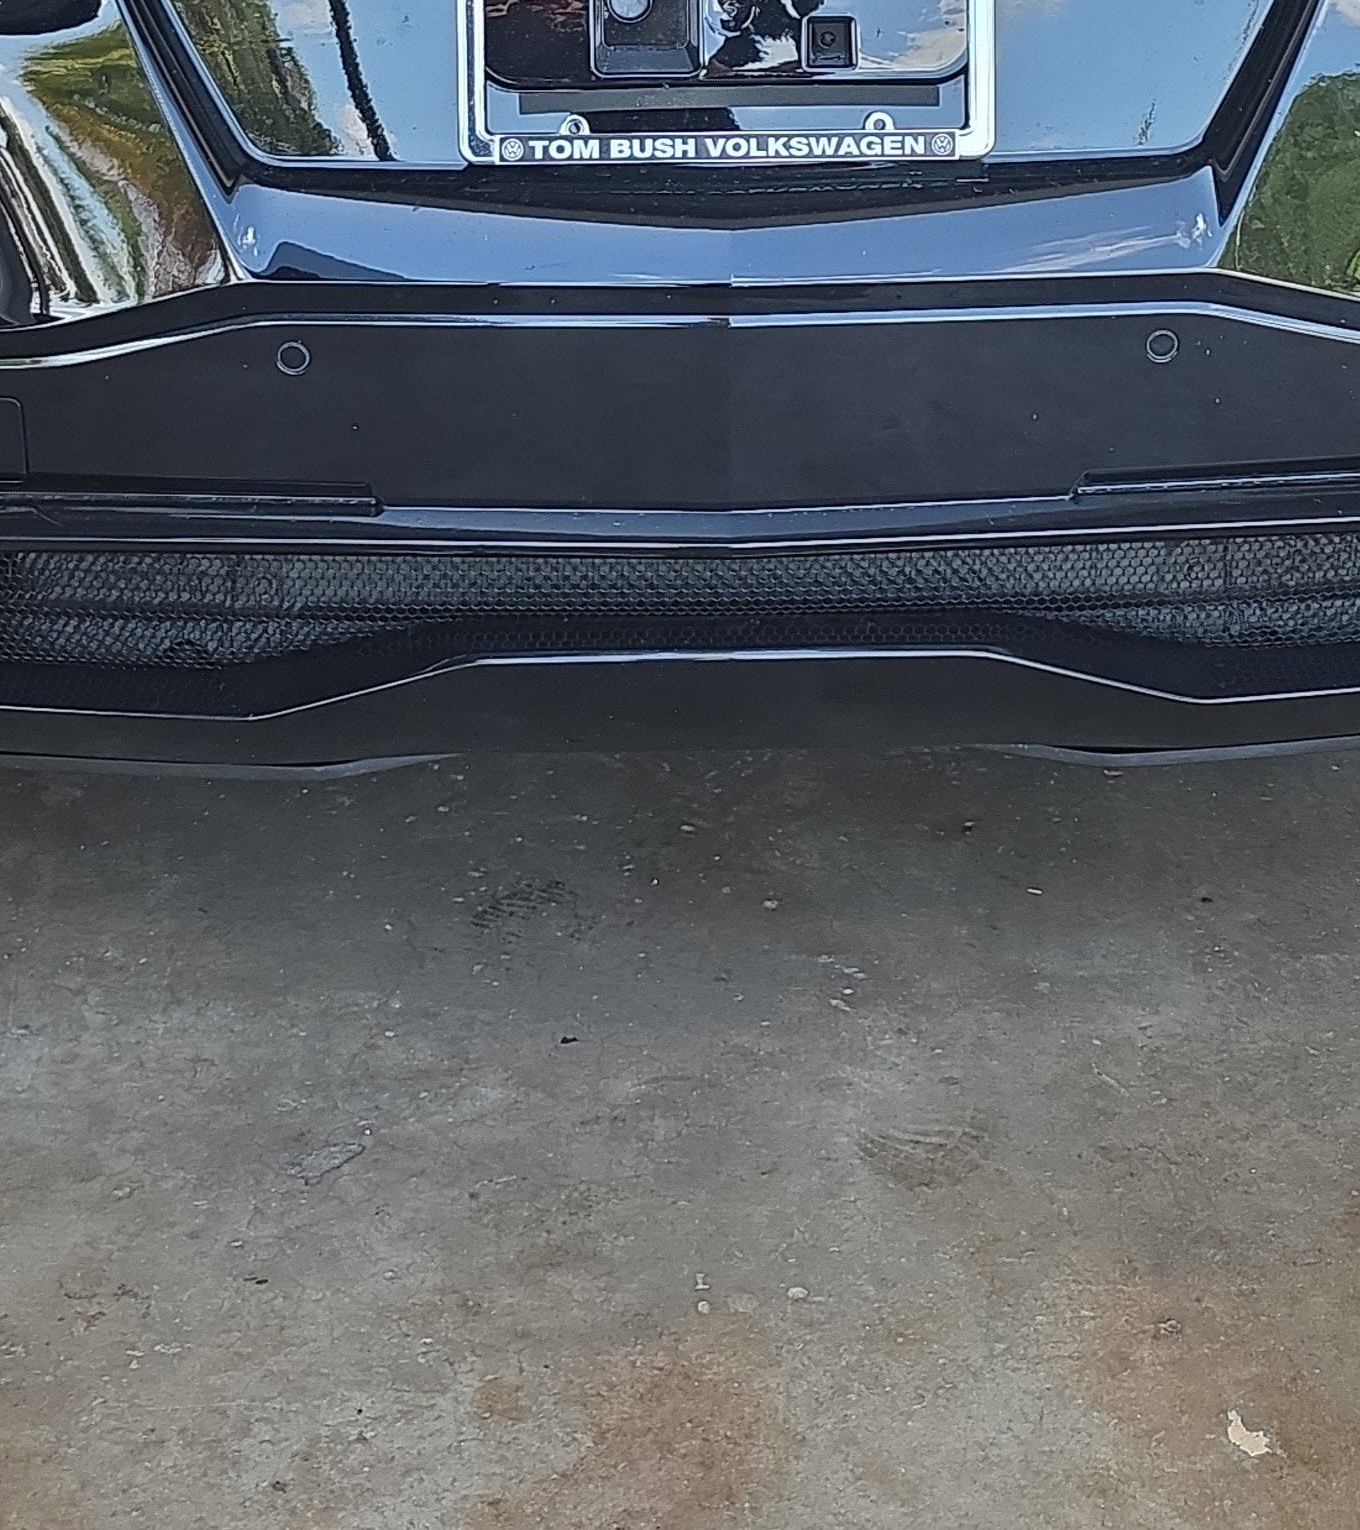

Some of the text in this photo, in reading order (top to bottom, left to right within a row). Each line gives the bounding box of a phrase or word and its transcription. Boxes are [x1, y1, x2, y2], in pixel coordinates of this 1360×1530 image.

[528, 139, 601, 160] TOM
[609, 138, 697, 159] BUSH
[705, 135, 926, 159] VOLKSWAGEN
